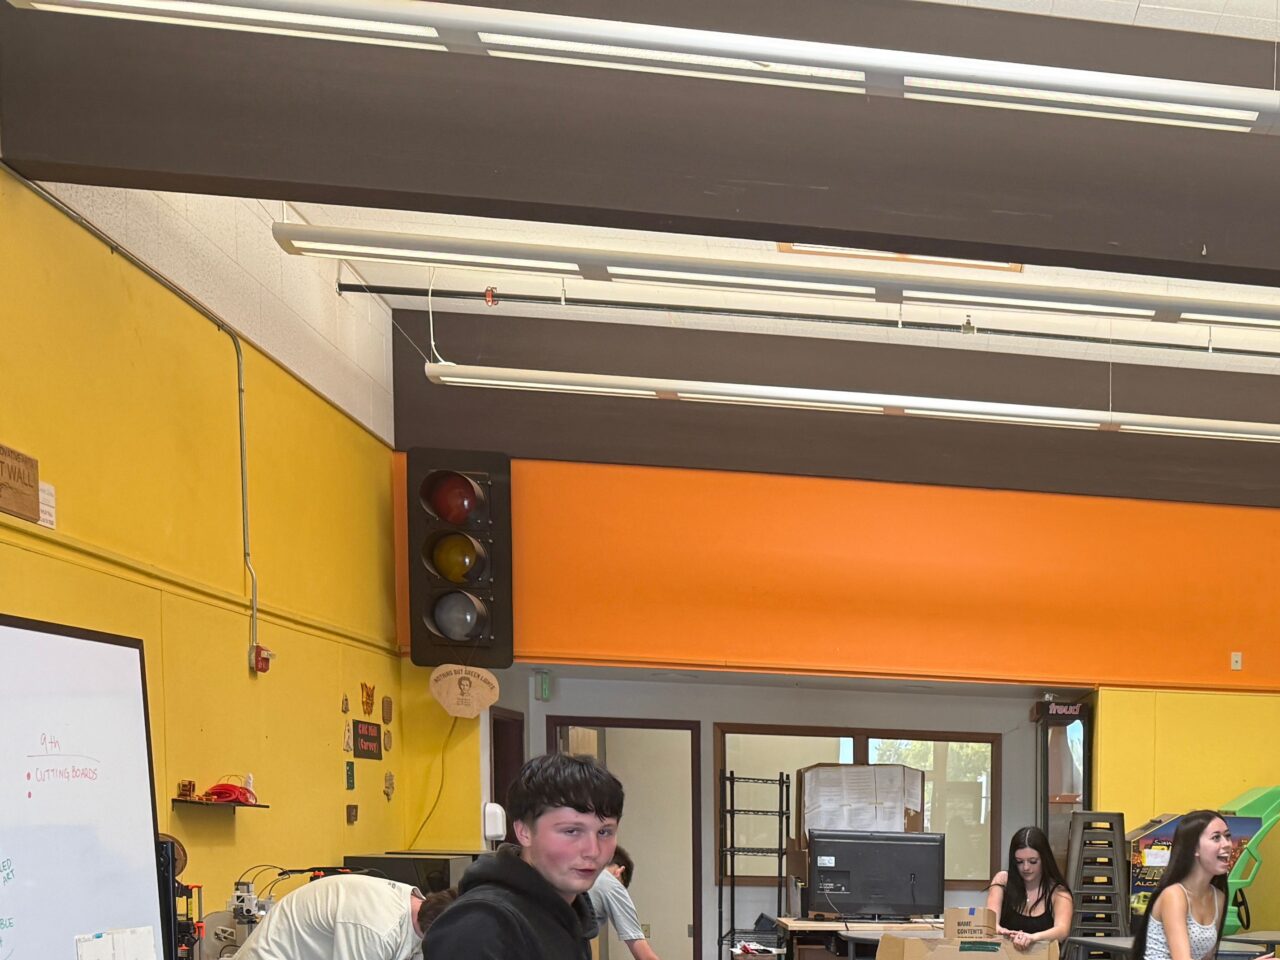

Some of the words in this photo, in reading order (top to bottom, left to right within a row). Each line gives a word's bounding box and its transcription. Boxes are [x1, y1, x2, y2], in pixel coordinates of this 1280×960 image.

[7, 463, 34, 488] WALL
[35, 767, 71, 782] CUTTING
[71, 765, 98, 781] BOARDS
